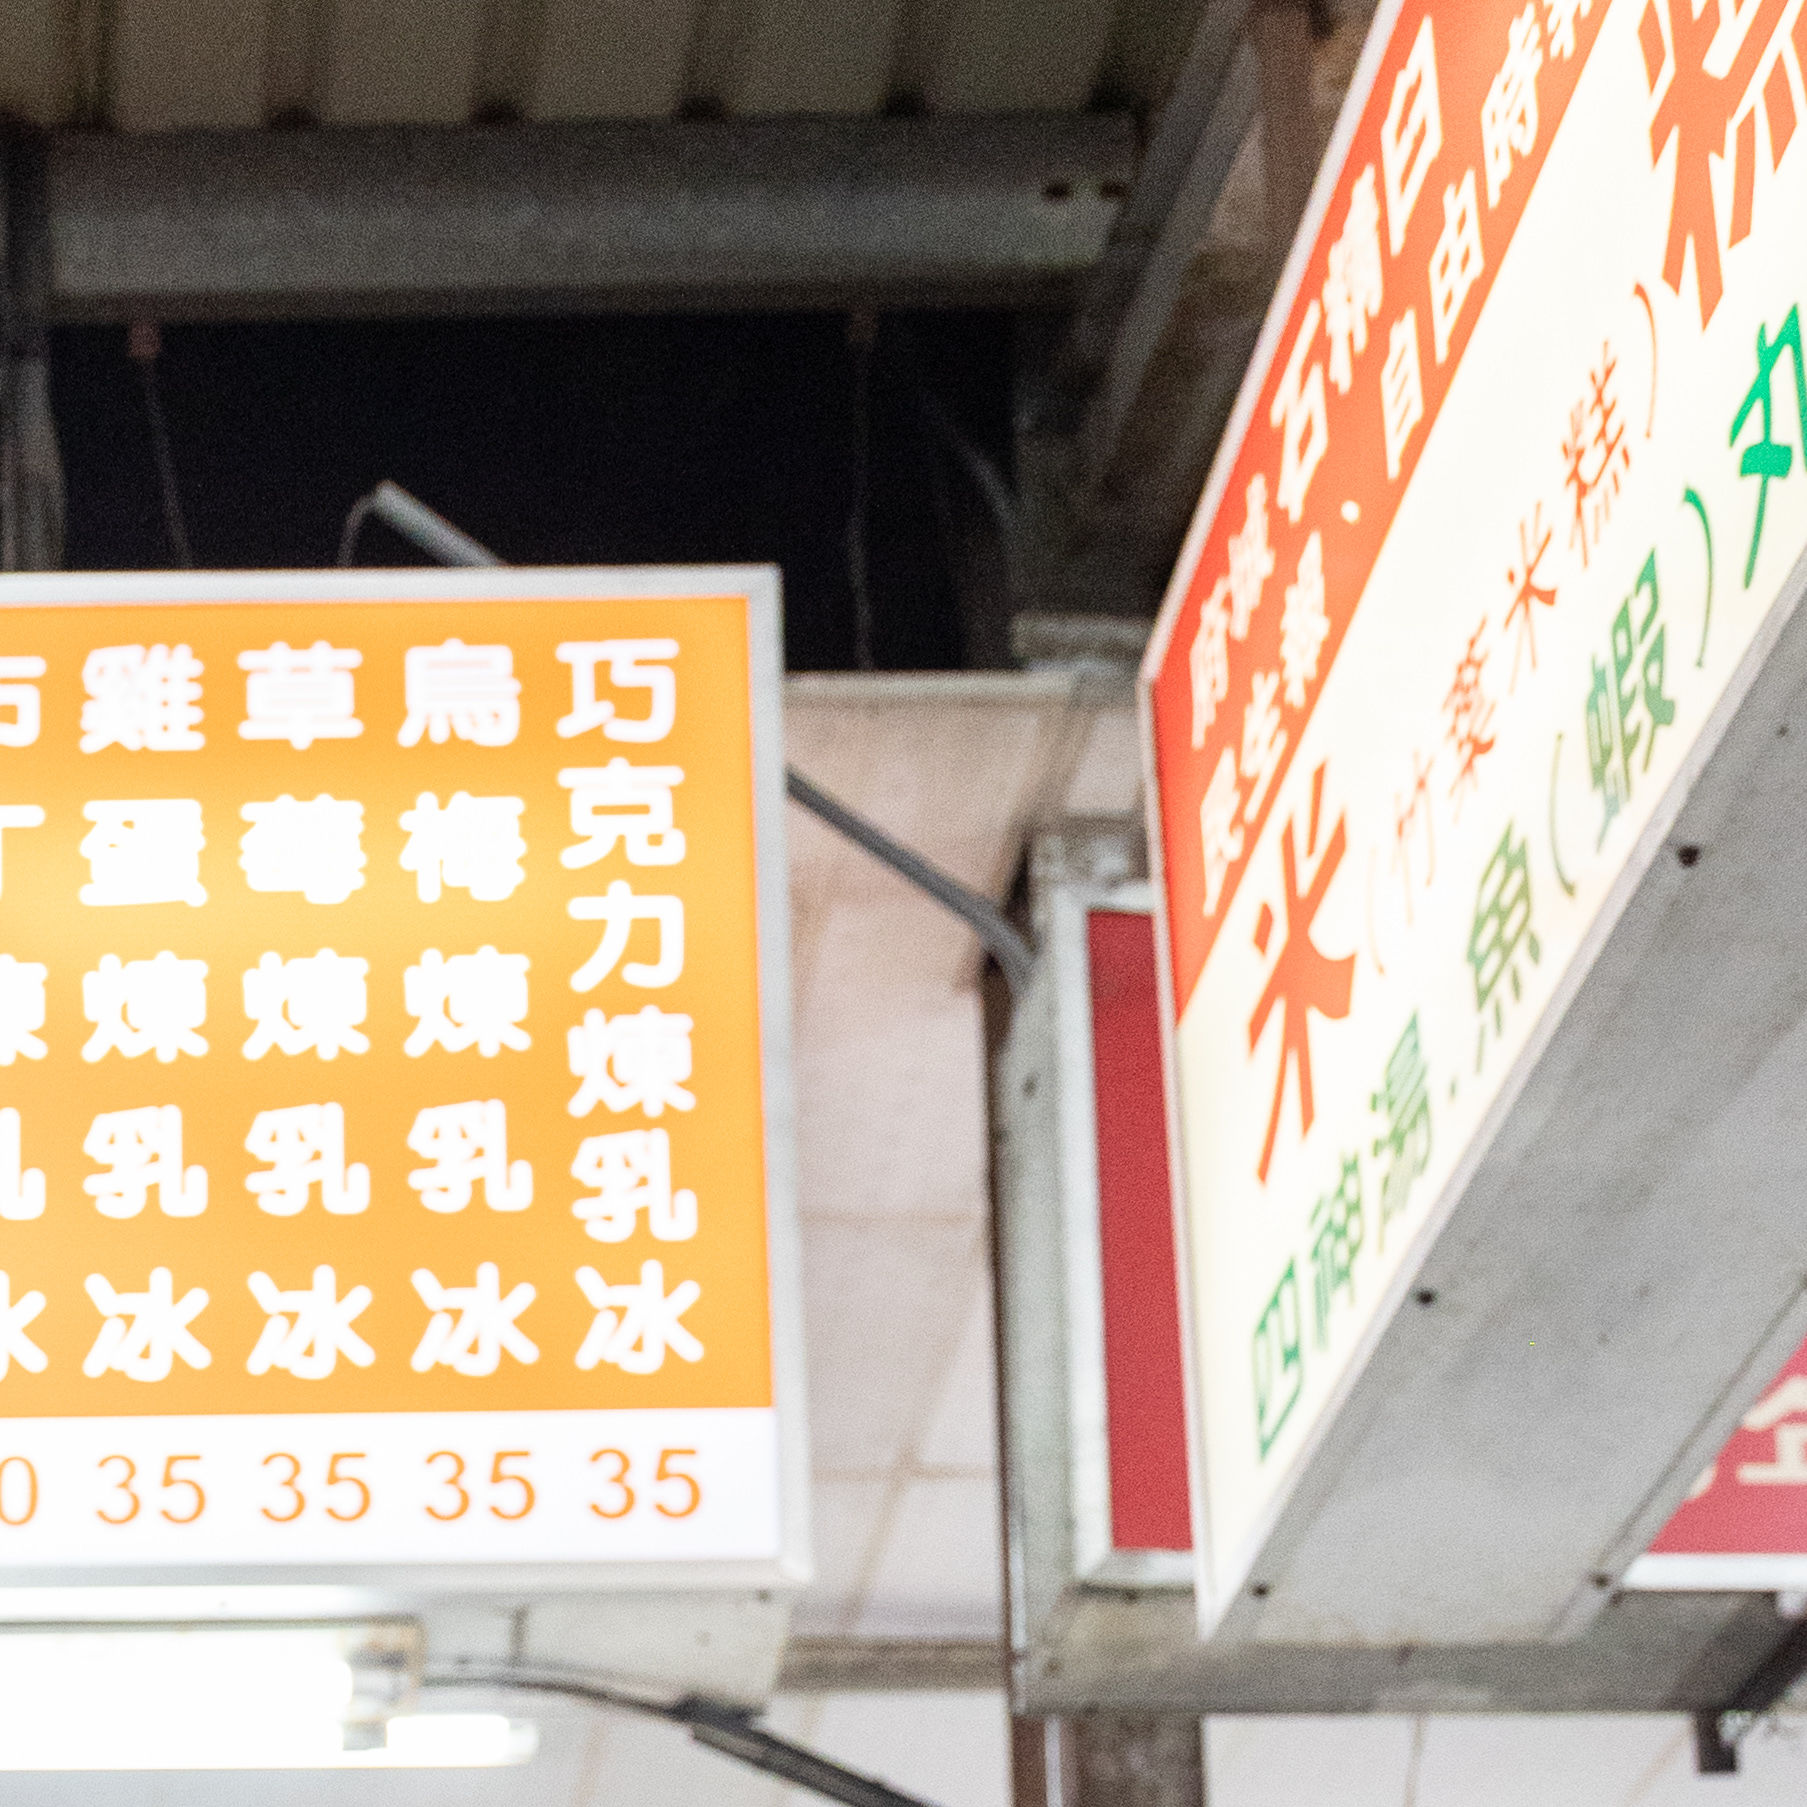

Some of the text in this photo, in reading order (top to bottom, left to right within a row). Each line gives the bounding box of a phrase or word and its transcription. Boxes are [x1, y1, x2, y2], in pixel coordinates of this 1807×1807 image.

[79, 643, 211, 1384] 雞蛋煉乳冰
[238, 639, 374, 1381] 草莓煉乳冰
[556, 637, 705, 1376] 巧克力煉乳冰
[94, 1452, 208, 1527] 35
[259, 1451, 372, 1525] 35
[423, 1449, 537, 1523] 35
[587, 1446, 702, 1522] 35
